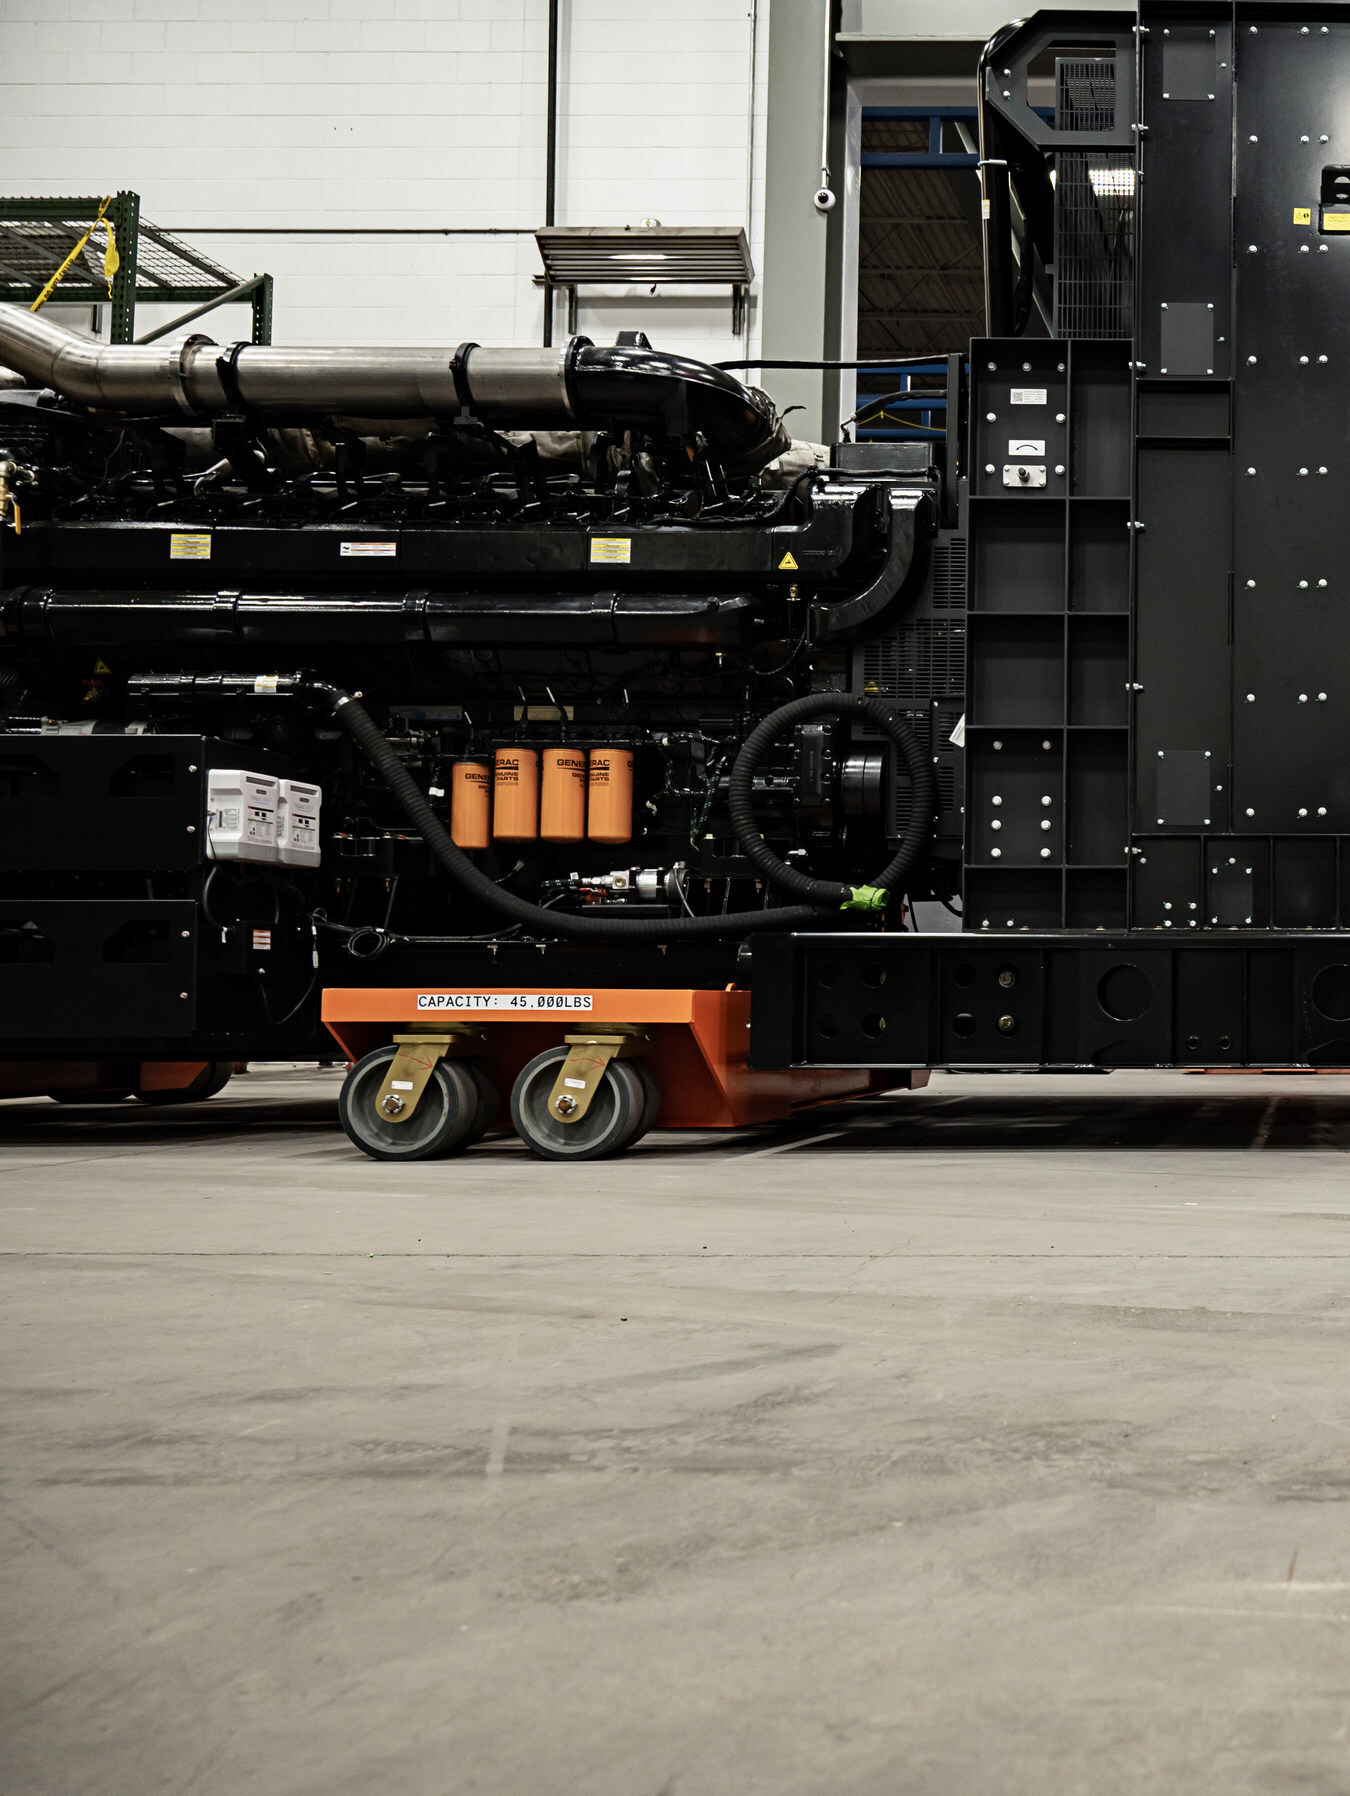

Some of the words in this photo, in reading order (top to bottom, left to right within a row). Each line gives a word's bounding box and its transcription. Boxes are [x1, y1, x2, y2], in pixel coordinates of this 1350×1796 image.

[557, 759, 586, 767] GENE
[418, 996, 499, 1007] CAPACITY:
[510, 996, 591, 1008] 45,000LBS
